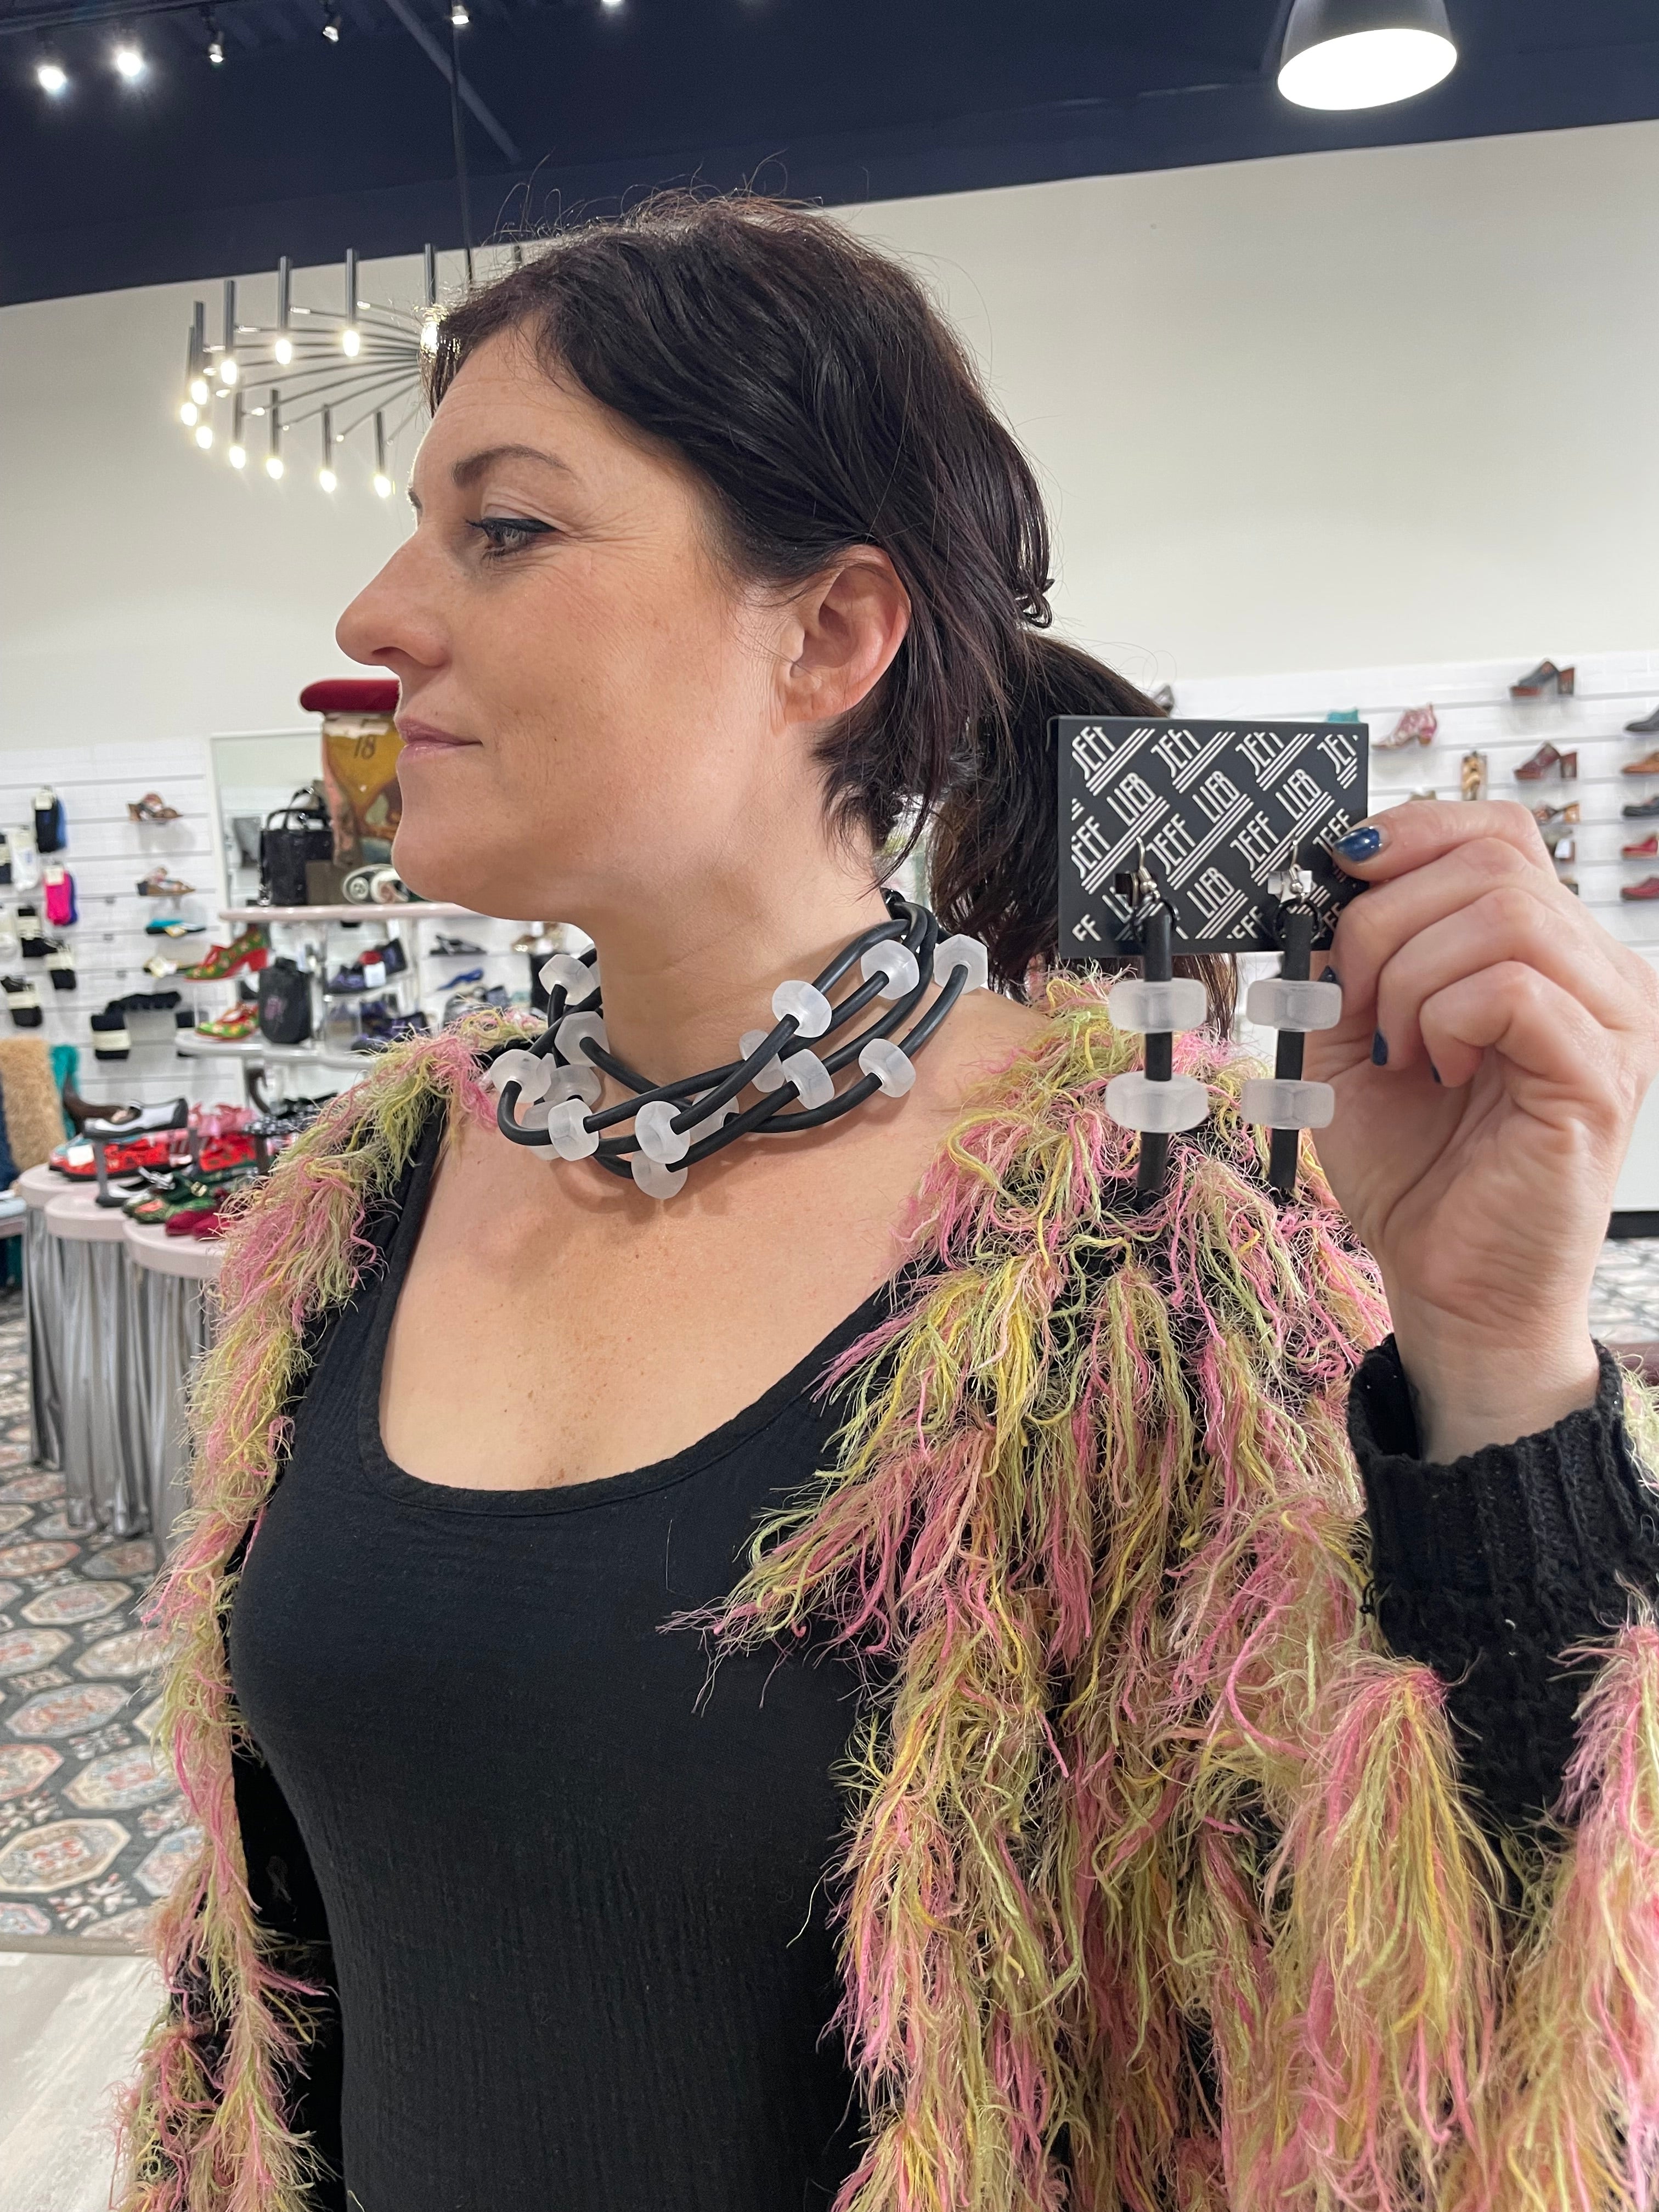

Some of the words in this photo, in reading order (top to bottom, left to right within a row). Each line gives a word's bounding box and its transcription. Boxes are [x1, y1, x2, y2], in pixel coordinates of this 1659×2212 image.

[1106, 772, 1156, 827] LIEB
[1145, 813, 1196, 875] JEFF
[1192, 770, 1240, 823] LIEB
[1229, 810, 1279, 872] JEFF
[1275, 769, 1322, 821] LIEB
[1186, 867, 1234, 919] LIEB
